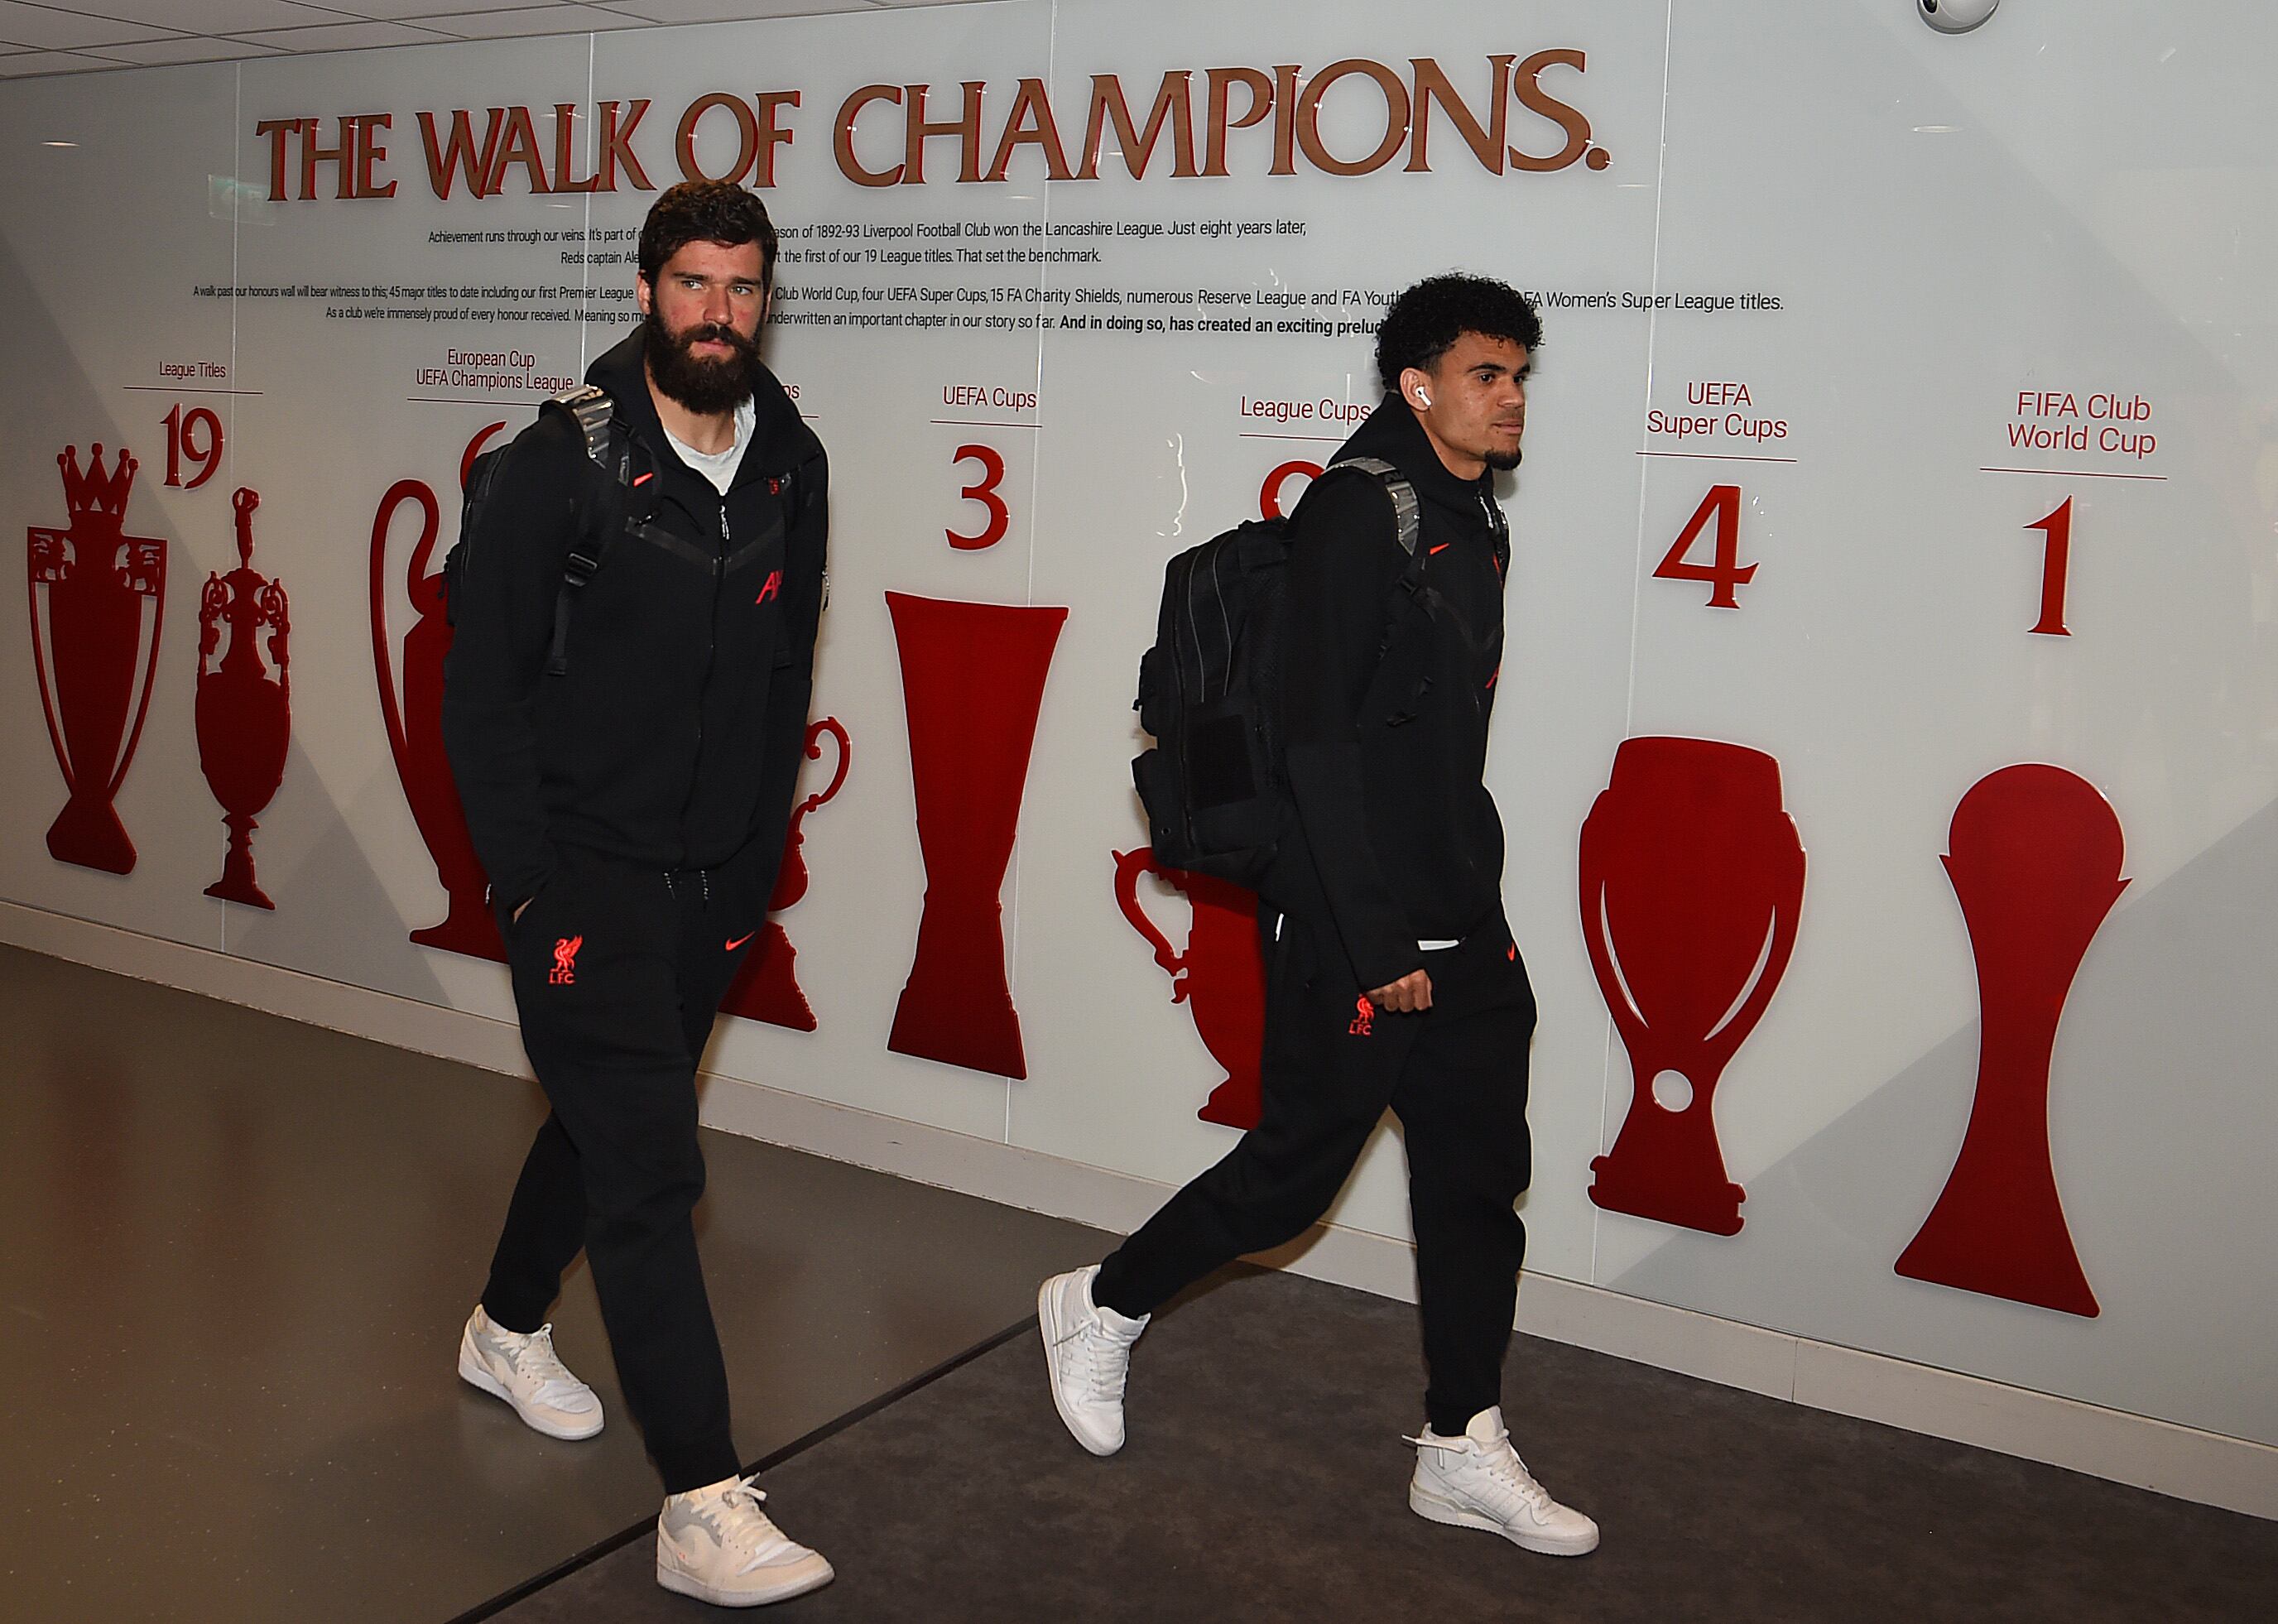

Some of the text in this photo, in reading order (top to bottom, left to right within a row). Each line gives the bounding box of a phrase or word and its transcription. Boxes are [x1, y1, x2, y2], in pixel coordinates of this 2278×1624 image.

[256, 49, 1611, 200] THE WALK OF CHAMPIONS.
[429, 231, 483, 243] Achievement
[486, 233, 505, 242] runs
[507, 229, 541, 244] through
[544, 233, 559, 241] our
[561, 232, 585, 241] veins.
[589, 228, 602, 240] It's
[604, 229, 623, 243] part
[626, 228, 637, 240] of
[774, 228, 799, 238] ason
[802, 224, 814, 238] of
[817, 224, 859, 238] 1892-93
[863, 223, 913, 240] Liverpool
[917, 223, 960, 237] Football
[965, 223, 990, 236] Club
[994, 226, 1018, 236] won
[1023, 222, 1041, 236] the
[1045, 221, 1113, 235] Lancashire
[1117, 222, 1164, 238] League.
[1168, 221, 1195, 234] Just
[1200, 219, 1232, 238] eight
[1237, 223, 1271, 238] years
[1276, 219, 1306, 236] later,
[561, 252, 584, 263] Reds
[587, 252, 622, 267] captain
[785, 249, 801, 262] the
[805, 249, 825, 262] first
[829, 249, 840, 262] of
[843, 252, 861, 262] our
[864, 249, 877, 262] 19
[881, 249, 921, 266] League
[925, 248, 954, 262] titles.
[956, 248, 983, 262] That
[986, 250, 1003, 262] set
[1007, 247, 1026, 262] the
[1029, 247, 1102, 262] benchmark.
[194, 286, 199, 295] A
[200, 286, 216, 296] walk
[218, 286, 233, 298] past
[235, 288, 248, 296] our
[249, 286, 278, 296] honours
[281, 286, 295, 296] wall
[297, 286, 310, 296] will
[310, 286, 328, 296] bear
[330, 286, 359, 297] witness
[362, 287, 370, 297] to
[389, 286, 400, 297] 45
[401, 289, 425, 300] major
[427, 286, 447, 297] titles
[449, 287, 458, 297] to
[460, 286, 478, 297] date
[481, 286, 519, 301] including
[521, 289, 536, 298] our
[539, 286, 556, 298] first
[560, 286, 597, 298] Premier
[600, 286, 633, 301] League
[775, 288, 799, 300] Club
[802, 286, 832, 300] World
[835, 287, 860, 303] Cup,
[863, 286, 884, 300] four
[887, 288, 917, 300] UEFA
[920, 288, 954, 305] Super
[957, 288, 988, 305] Cups,
[991, 288, 1003, 301] 15
[1007, 288, 1022, 301] FA
[1026, 288, 1070, 305] Charity
[1075, 288, 1122, 305] Shields,
[1127, 292, 1193, 303] numerous
[1199, 290, 1252, 304] Reserve
[1257, 290, 1306, 308] League
[1311, 290, 1337, 305] and
[1343, 291, 1361, 305] FA
[1546, 291, 1616, 307] Women's
[1622, 292, 1671, 312] Super
[1675, 293, 1734, 313] League
[1740, 293, 1784, 310] titles.
[326, 307, 336, 317] As
[339, 310, 344, 318] a
[345, 306, 362, 318] club
[364, 307, 384, 318] we're
[387, 307, 431, 322] immensely
[434, 308, 458, 322] proud
[460, 307, 469, 320] of
[471, 311, 495, 323] every
[497, 308, 528, 320] honour
[531, 309, 570, 321] received.
[574, 310, 615, 324] Meaning
[618, 313, 629, 322] so
[834, 315, 846, 324] an
[849, 312, 902, 329] important
[905, 312, 947, 329] chapter
[950, 317, 959, 326] in
[963, 317, 982, 327] our
[985, 315, 1016, 331] story
[1018, 318, 1032, 328] so
[1036, 314, 1055, 329] far.
[1060, 315, 1086, 329] And
[1090, 319, 1102, 329] in
[1107, 315, 1143, 333] doing
[1146, 320, 1165, 333] so,
[1170, 316, 1194, 330] has
[1198, 317, 1251, 331] created
[1255, 321, 1272, 332] an
[1277, 318, 1333, 337] exciting
[160, 362, 226, 380] League Titles
[448, 349, 535, 371] European Cup
[417, 368, 573, 393] UEFA Champions League
[1687, 382, 1752, 406] UEFA
[943, 386, 1036, 411] UEFA Cups
[1241, 396, 1372, 425] League Cups
[2017, 392, 2151, 420] FIFA Club
[1646, 411, 1787, 443] Super Cups
[160, 403, 224, 489] 19
[2007, 424, 2155, 459] World Cup
[944, 444, 1011, 551] 3
[1652, 484, 1759, 610] 4
[2022, 495, 2073, 637] 1
[549, 973, 574, 983] LFC
[1349, 1022, 1371, 1035] LFC
